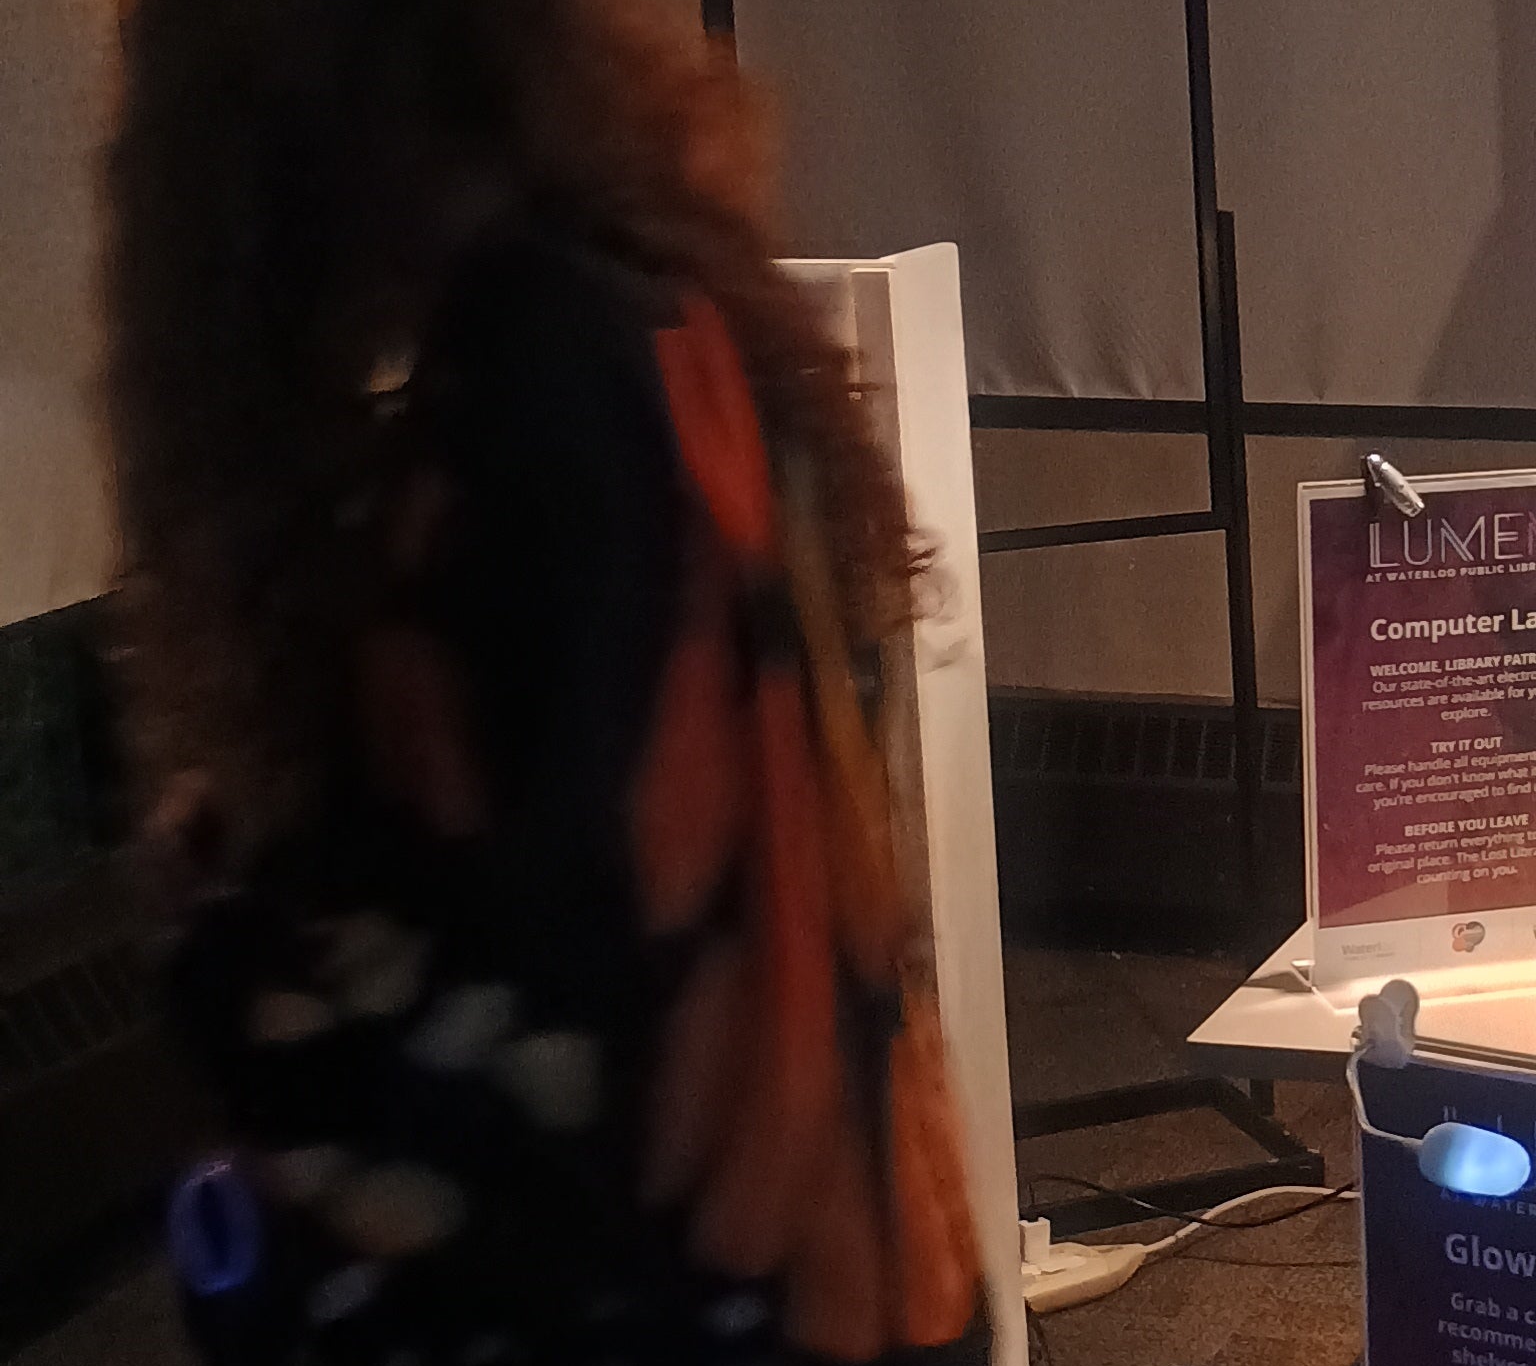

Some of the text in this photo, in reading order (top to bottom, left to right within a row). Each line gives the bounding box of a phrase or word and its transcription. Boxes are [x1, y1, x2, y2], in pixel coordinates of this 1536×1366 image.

[1365, 572, 1383, 583] AT
[1387, 568, 1456, 582] WATERLOO
[1460, 564, 1505, 576] PUBLIC
[1370, 613, 1505, 643] Computer
[1445, 655, 1501, 671] LIBRARY
[1373, 681, 1398, 693] Our
[1400, 672, 1494, 692] state-of-the-art
[1362, 696, 1424, 711] resources
[1427, 694, 1448, 706] are
[1450, 687, 1505, 704] available
[1508, 685, 1525, 698] for
[1440, 706, 1492, 723] explore.
[1430, 736, 1503, 754] TRY IT OUT
[1364, 762, 1406, 776] Please
[1408, 758, 1450, 772] handle
[1453, 755, 1468, 768] all
[1471, 750, 1536, 767] equipment
[1355, 782, 1387, 793] care.
[1401, 778, 1424, 792] you
[1427, 773, 1460, 787] don't
[1462, 770, 1495, 784] know
[1498, 766, 1529, 780] what
[1373, 793, 1413, 811] you're
[1416, 786, 1490, 803] encouraged
[1491, 785, 1505, 798] to
[1507, 781, 1532, 795] find
[1404, 813, 1529, 837] BEFORE YOU LEAVE
[1375, 842, 1415, 856] Please
[1418, 838, 1458, 852] return
[1460, 831, 1525, 848] everything
[1367, 857, 1414, 875] original
[1457, 851, 1479, 865] The
[1481, 848, 1508, 862] Lost
[1416, 868, 1470, 885] counting
[1473, 866, 1490, 877] on
[1450, 1292, 1502, 1318] Grab
[1505, 1303, 1519, 1321] a
